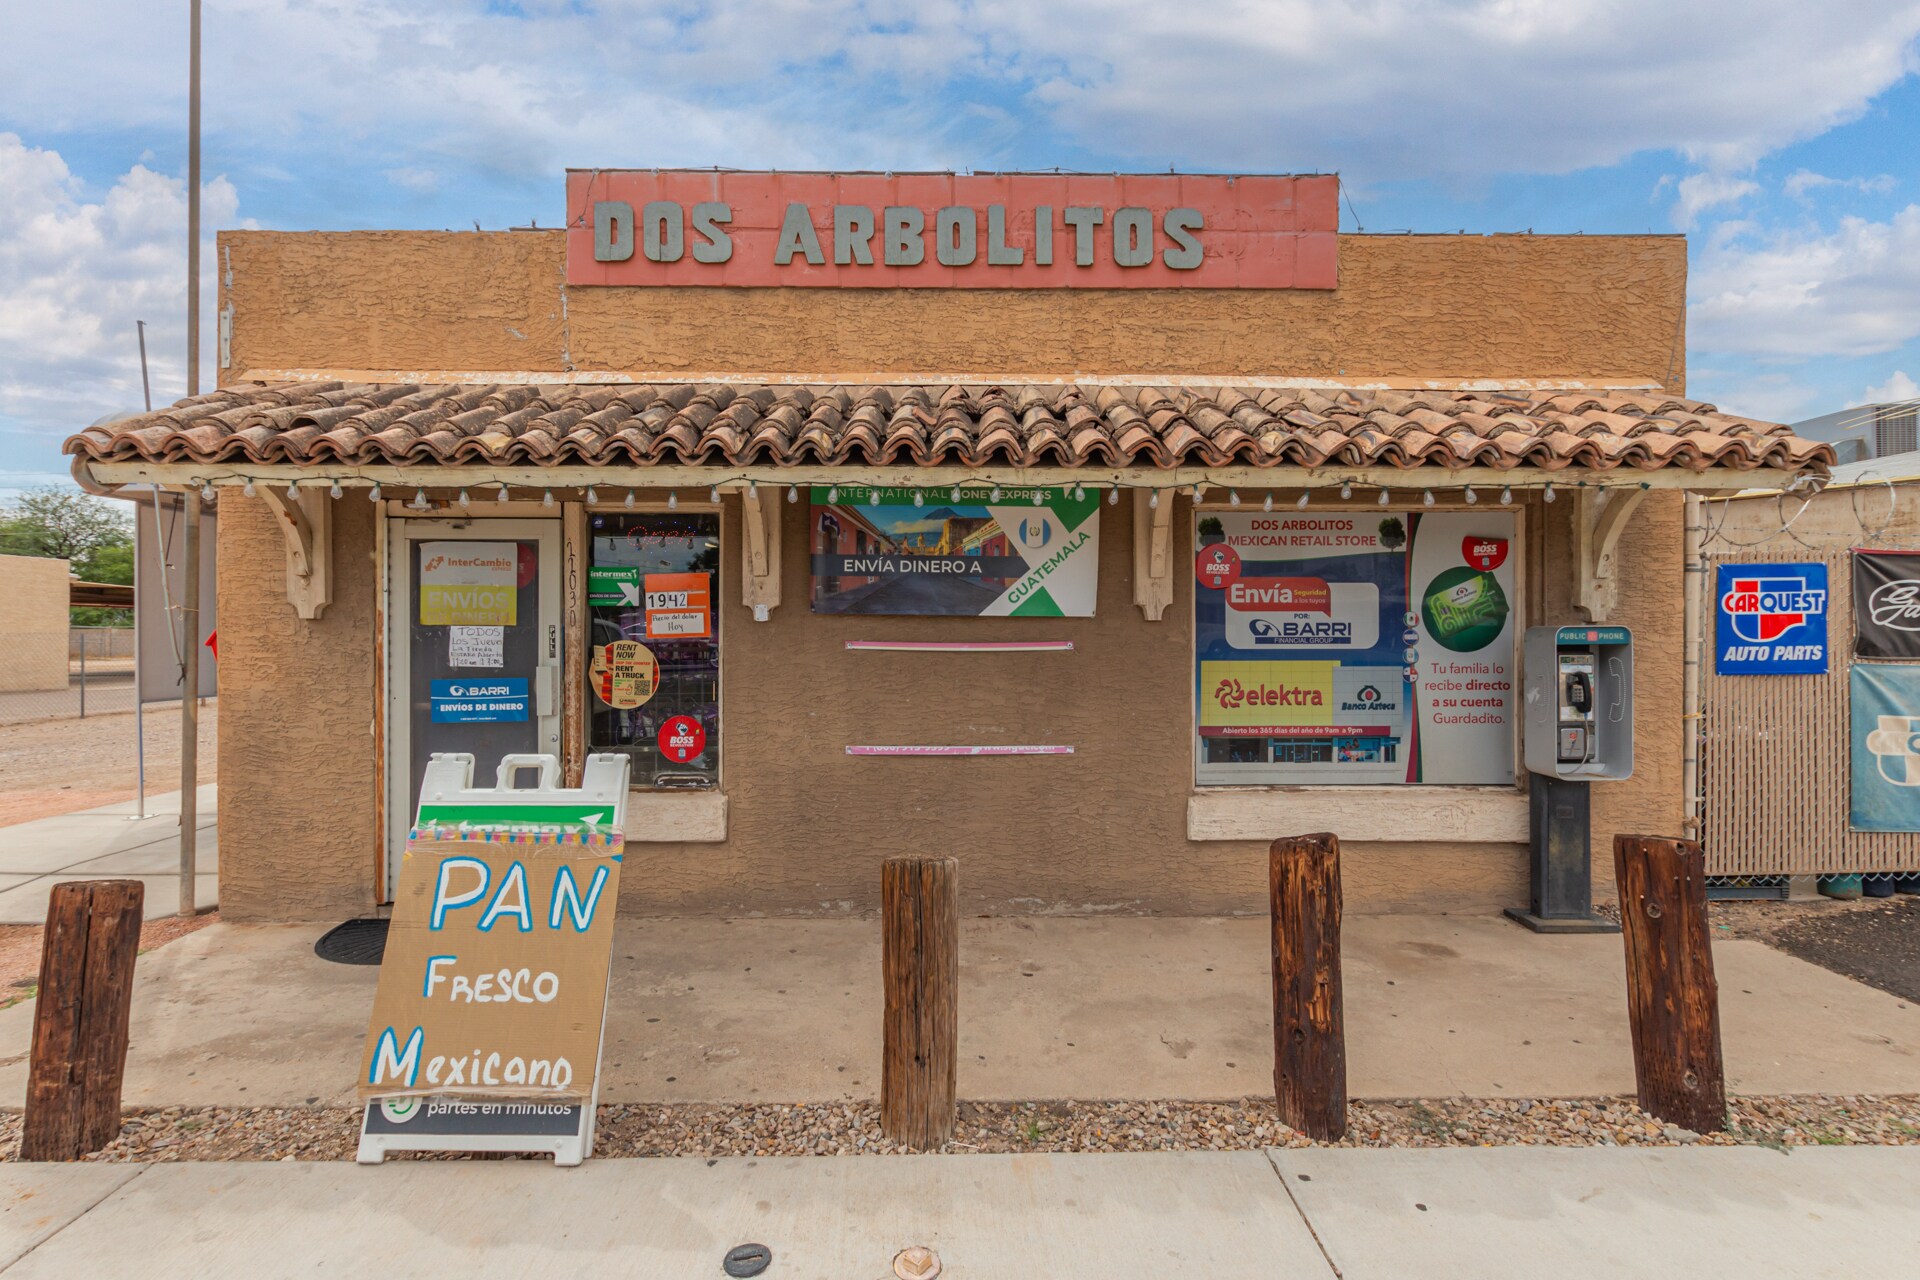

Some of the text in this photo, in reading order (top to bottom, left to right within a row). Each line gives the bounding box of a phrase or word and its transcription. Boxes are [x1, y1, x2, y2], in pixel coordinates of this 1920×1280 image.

[594, 201, 1205, 271] DOS ARBOLITOS
[836, 488, 947, 498] NTERNATIONAL
[951, 489, 993, 499] ONEY
[1251, 520, 1353, 531] DOS ARBOLITOS
[1228, 535, 1376, 546] MEXICAN RETAIL STORE
[1473, 545, 1497, 553] BOSS
[448, 557, 512, 567] InterCambio
[844, 556, 982, 573] ENVÍA DINERO A
[1006, 531, 1091, 604] GUATEMALA
[1206, 563, 1230, 571] BOSS
[428, 587, 509, 609] ENVÍOS
[1231, 583, 1292, 604] Envía
[1294, 589, 1327, 597] Seguridad
[1725, 592, 1823, 613] CARQUEST
[457, 626, 501, 637] TODOS
[668, 622, 684, 632] Hoy
[1283, 622, 1352, 636] BARRI
[1560, 632, 1624, 640] PUBLIC PHONE
[616, 643, 638, 651] RENT
[616, 651, 636, 659] NOW
[1723, 645, 1823, 661] AUTO PARTS
[1432, 662, 1504, 674] Tu familia lo
[1425, 679, 1511, 691] recibe directo
[469, 686, 510, 696] BARRI
[1246, 684, 1323, 706] elektra
[440, 702, 524, 712] ENVÍOS DE DINERO
[1341, 702, 1396, 711] Banco Azteca
[1432, 697, 1503, 707] a su cuenta
[1433, 712, 1505, 724] Guardadito.
[1347, 727, 1363, 735] 9pm
[670, 736, 694, 744] BOSS
[429, 855, 610, 933] PAN
[423, 955, 559, 1004] FRESCO
[369, 1025, 574, 1091] Mexicano
[426, 1101, 572, 1117] partes en minutos
